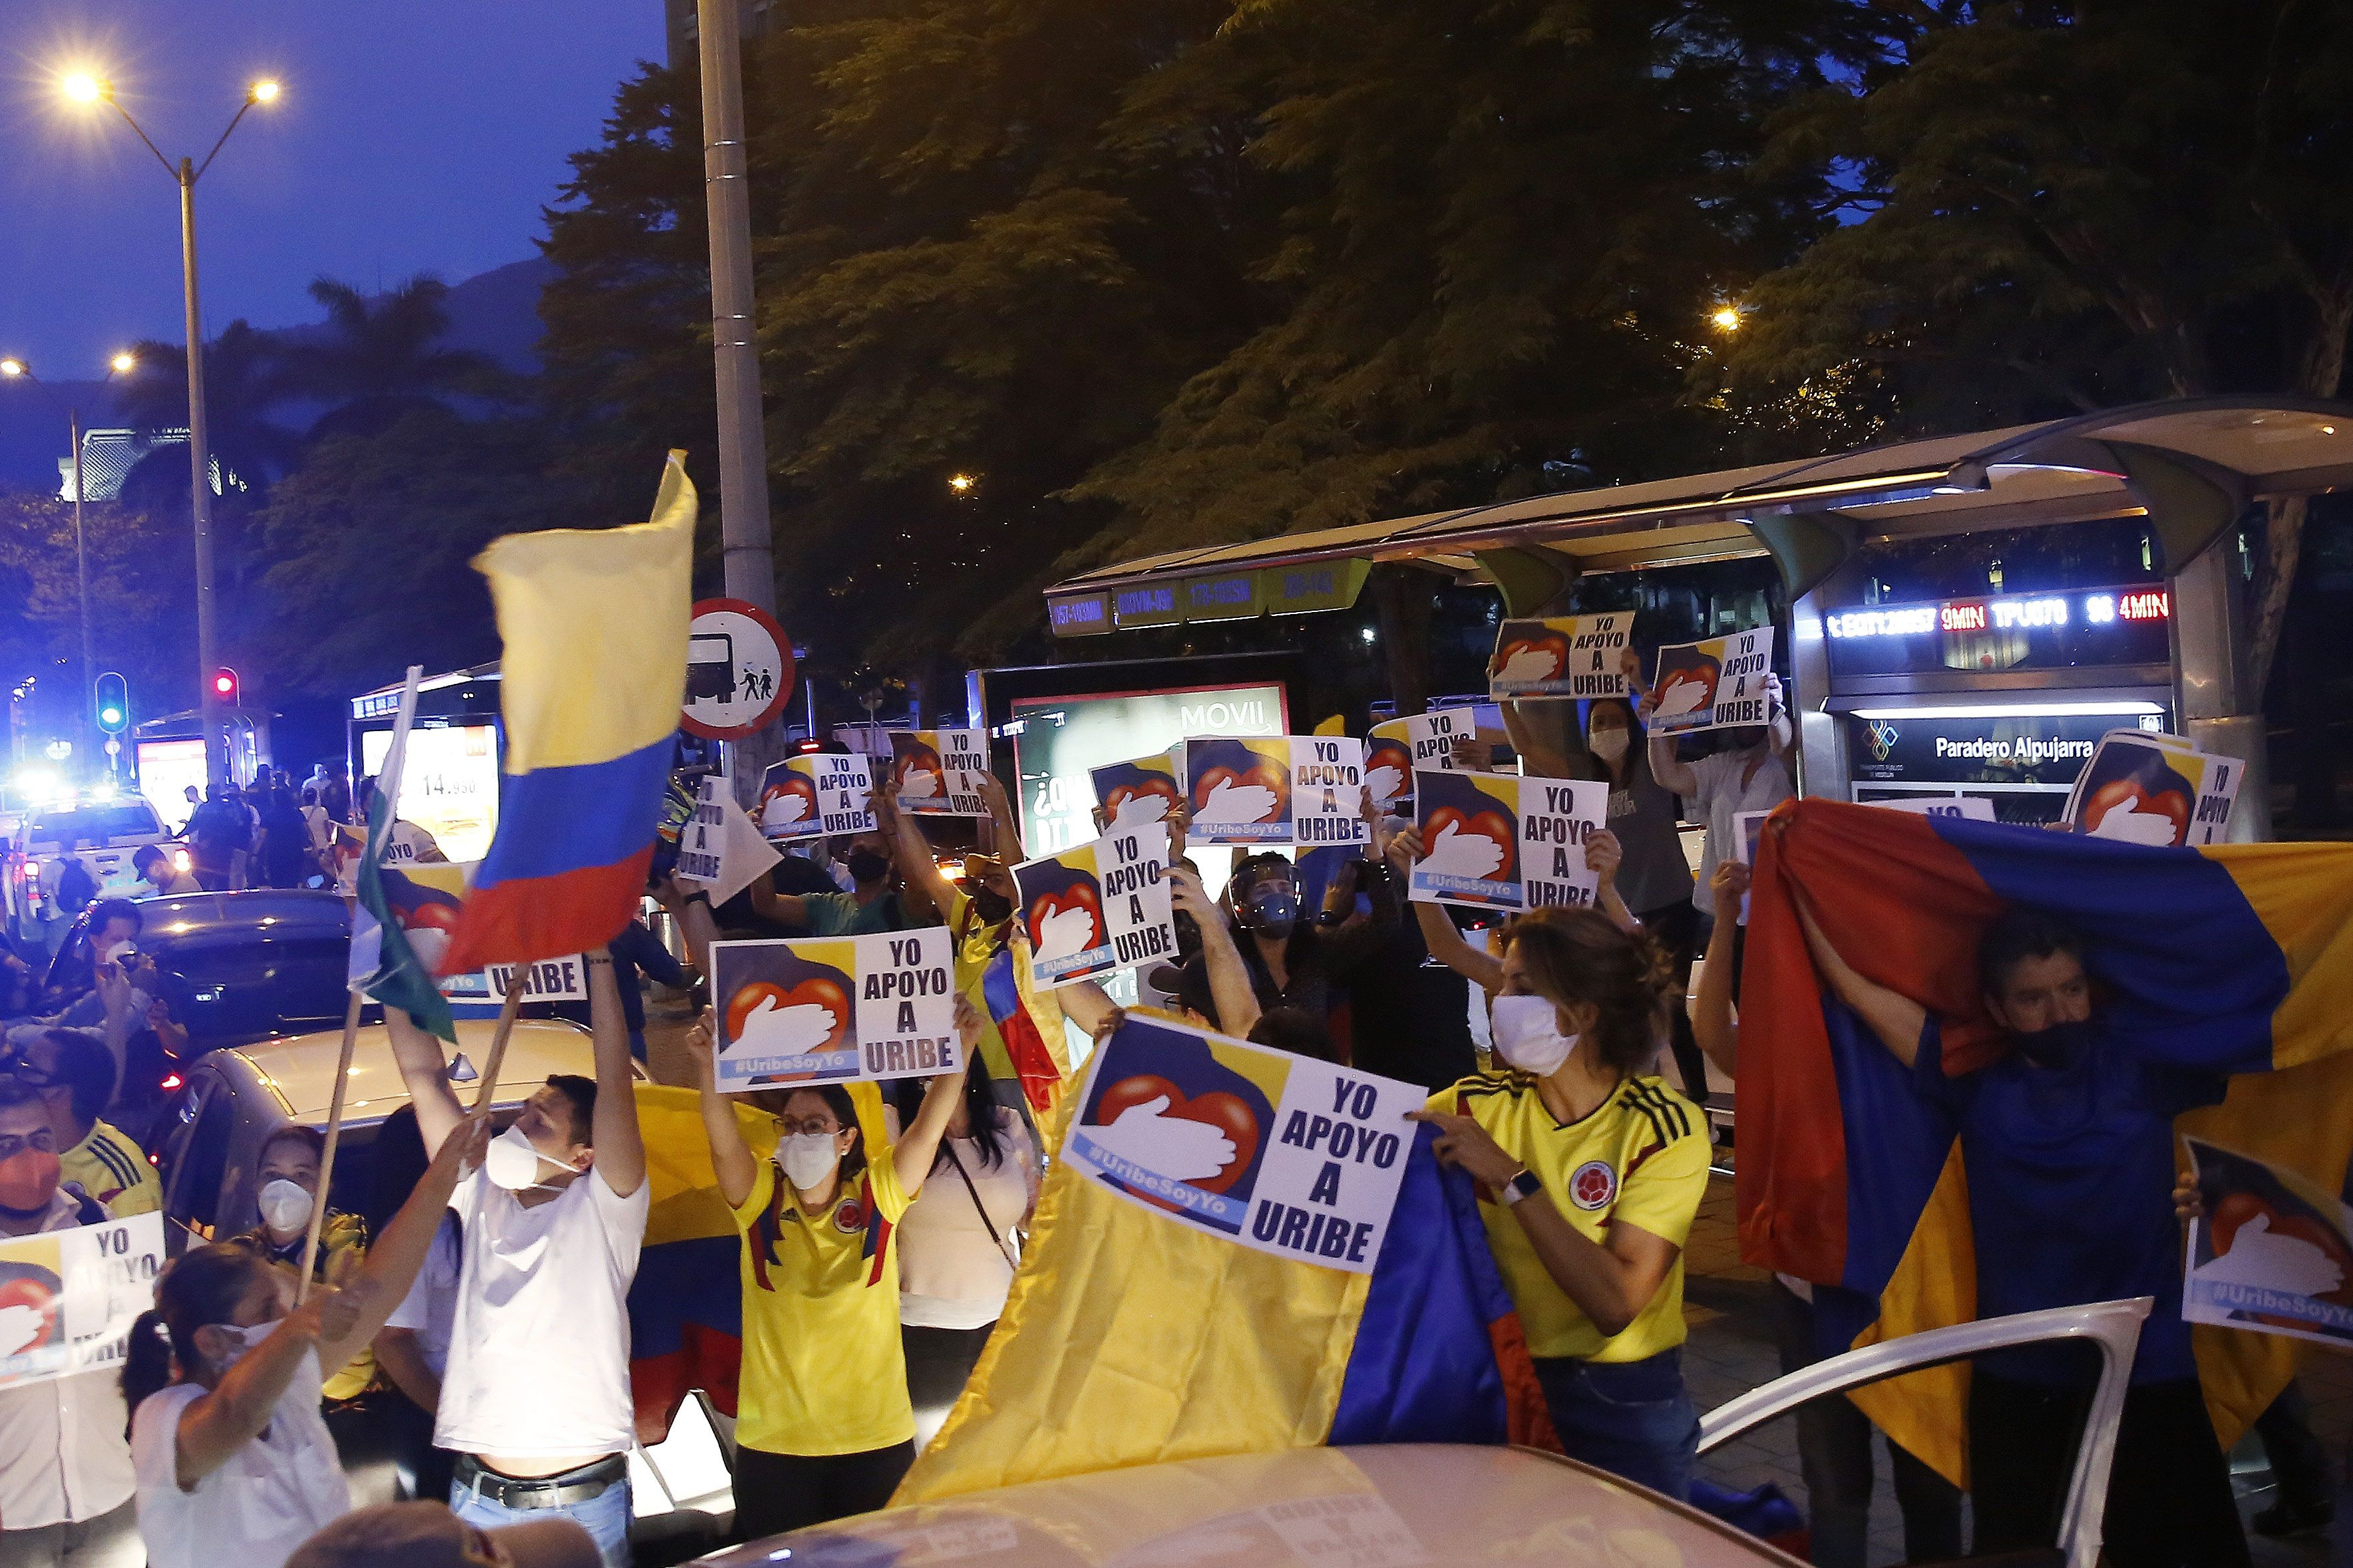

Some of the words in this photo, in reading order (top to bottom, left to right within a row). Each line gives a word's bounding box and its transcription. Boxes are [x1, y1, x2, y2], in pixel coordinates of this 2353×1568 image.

[1596, 616, 1614, 631] YO
[1940, 605, 1986, 631] 9MIN
[2119, 592, 2169, 619] 4MIN
[1574, 632, 1624, 649] APOYO
[1739, 635, 1755, 655] YO
[1591, 649, 1604, 671] A
[1723, 653, 1765, 677] APOYO
[1573, 674, 1624, 695] URIBE
[1733, 676, 1745, 697] A
[1180, 701, 1264, 730] MOVII
[1716, 699, 1763, 724] URIBE
[1428, 715, 1452, 735] YO
[952, 734, 968, 751] YO
[1314, 742, 1339, 762] YO
[1935, 736, 2011, 758] Paradero
[2014, 735, 2094, 762] Alpujarra
[830, 758, 850, 772] YO
[944, 753, 982, 770] APOYO
[820, 773, 866, 791] APOYO
[960, 773, 971, 791] A
[1298, 765, 1359, 786] APOYO
[840, 790, 852, 809] A
[1322, 788, 1338, 813] A
[1546, 786, 1574, 814] YO
[823, 810, 872, 832] URIBE
[1200, 823, 1281, 836] #UribeSoyYo
[1298, 817, 1364, 842] URIBE
[1115, 836, 1138, 863] YO
[1553, 847, 1570, 878] A
[1105, 860, 1161, 898] APOYO
[1129, 894, 1145, 925] A
[889, 938, 921, 967] YO
[1115, 923, 1172, 964] URIBE
[864, 967, 946, 1000] APOYO
[897, 1001, 918, 1032] A
[866, 1036, 953, 1072] URIBE
[1333, 1077, 1377, 1120] YO
[1281, 1109, 1400, 1170] APOYO
[1088, 1146, 1227, 1215] #UribeSoyYo
[1309, 1161, 1342, 1206] A
[96, 1226, 130, 1257] YO
[1252, 1199, 1374, 1263] URIBE
